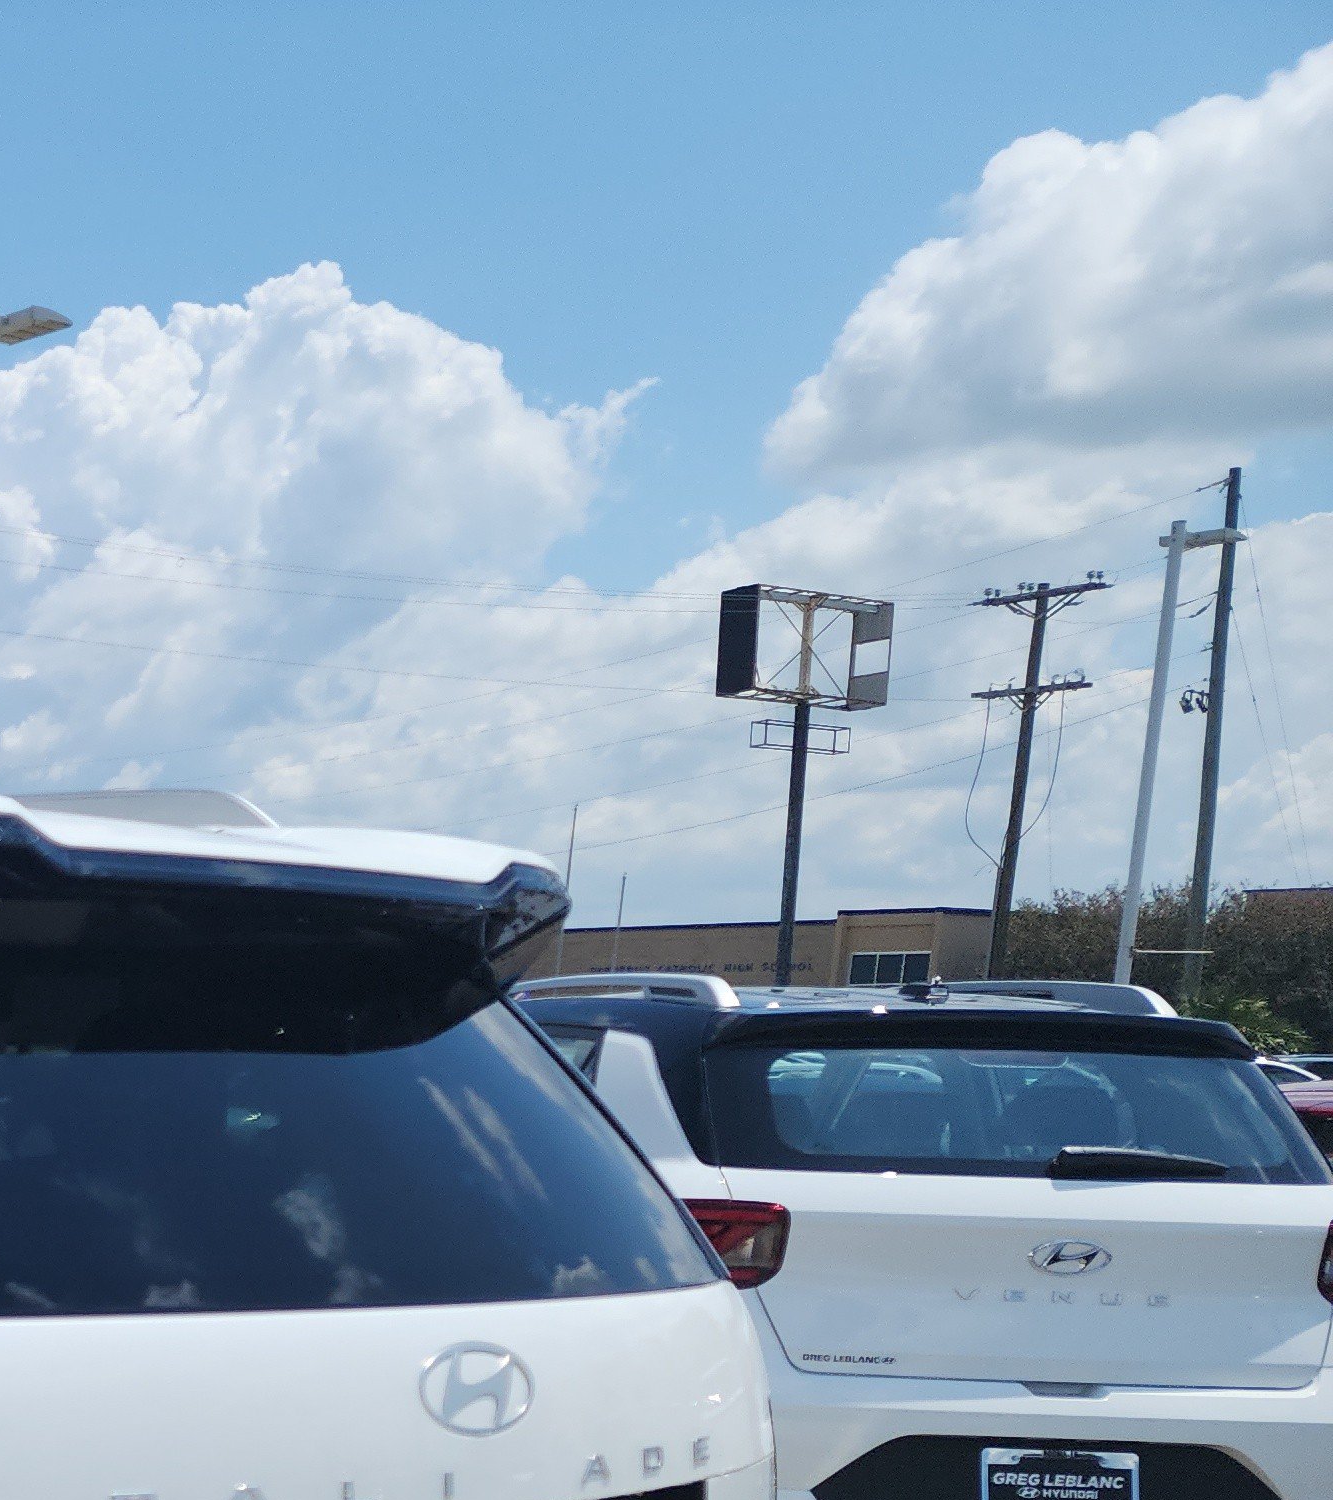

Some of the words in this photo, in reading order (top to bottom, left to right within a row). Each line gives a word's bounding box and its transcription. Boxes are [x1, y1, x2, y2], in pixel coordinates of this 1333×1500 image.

[953, 1287, 1172, 1307] VENUE
[802, 1353, 831, 1362] GREG
[992, 1472, 1041, 1486] GREG
[1043, 1474, 1125, 1489] LEBLANC
[1042, 1489, 1099, 1500] HYUNDAI
